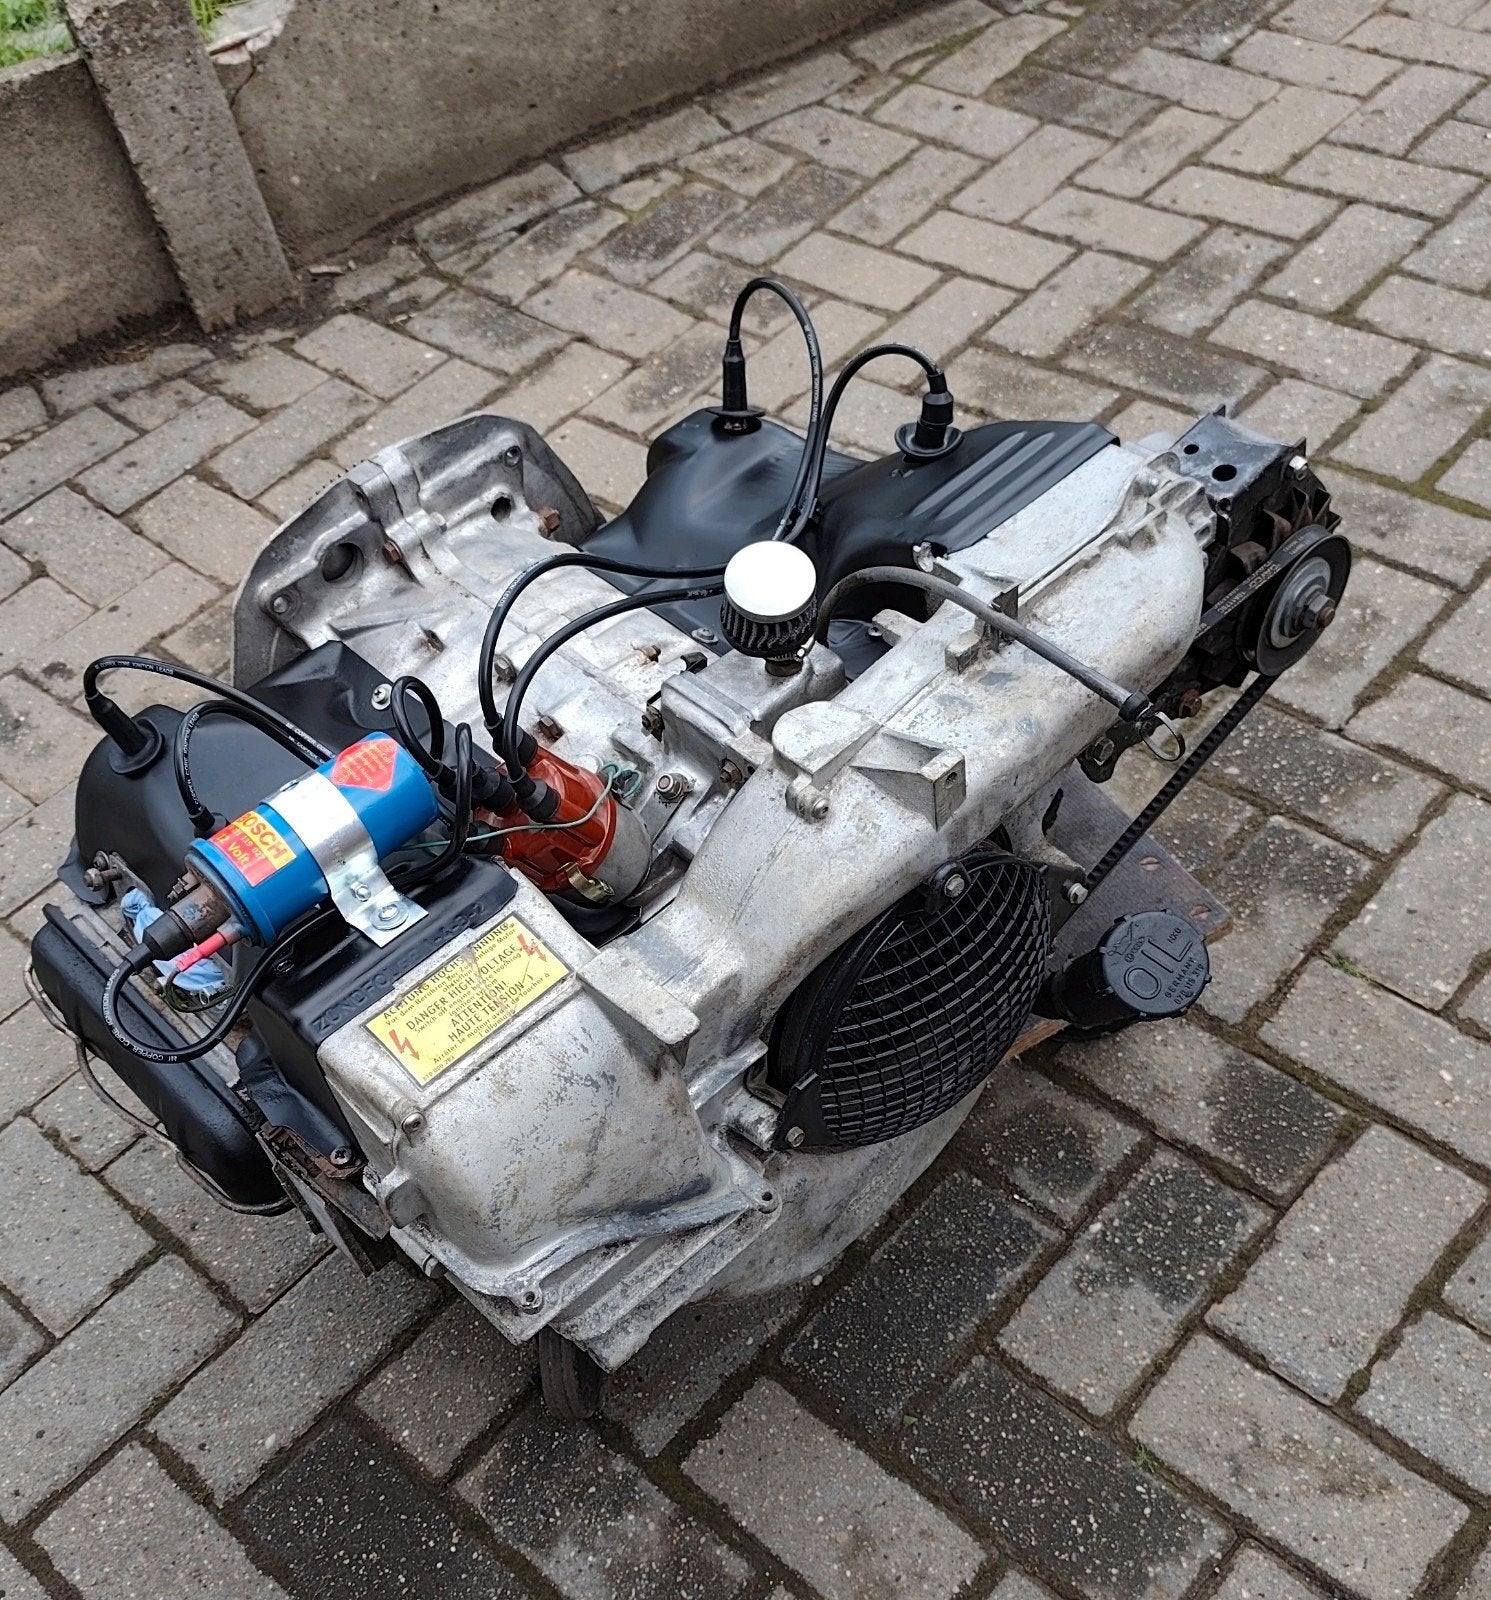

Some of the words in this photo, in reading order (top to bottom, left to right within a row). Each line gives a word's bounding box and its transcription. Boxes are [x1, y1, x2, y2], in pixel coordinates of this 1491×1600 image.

[227, 841, 251, 866] Volt
[238, 810, 287, 860] BOSCH
[105, 968, 120, 990] LEADS
[1124, 939, 1193, 1000] OIL
[1164, 956, 1196, 998] GERMANY
[102, 992, 114, 1026] IGNITION
[382, 981, 430, 1019] ACHTUNG
[405, 996, 447, 1030] DANGER
[448, 975, 474, 998] HIGH
[414, 1014, 437, 1034] Switch
[436, 1006, 448, 1017] off
[492, 951, 522, 975] touching
[448, 1013, 482, 1042] HAUTE
[481, 980, 525, 1016] TENSION
[450, 979, 509, 1027] ATTENTION!
[112, 1026, 130, 1047] CORE
[132, 1046, 164, 1062] COPPER
